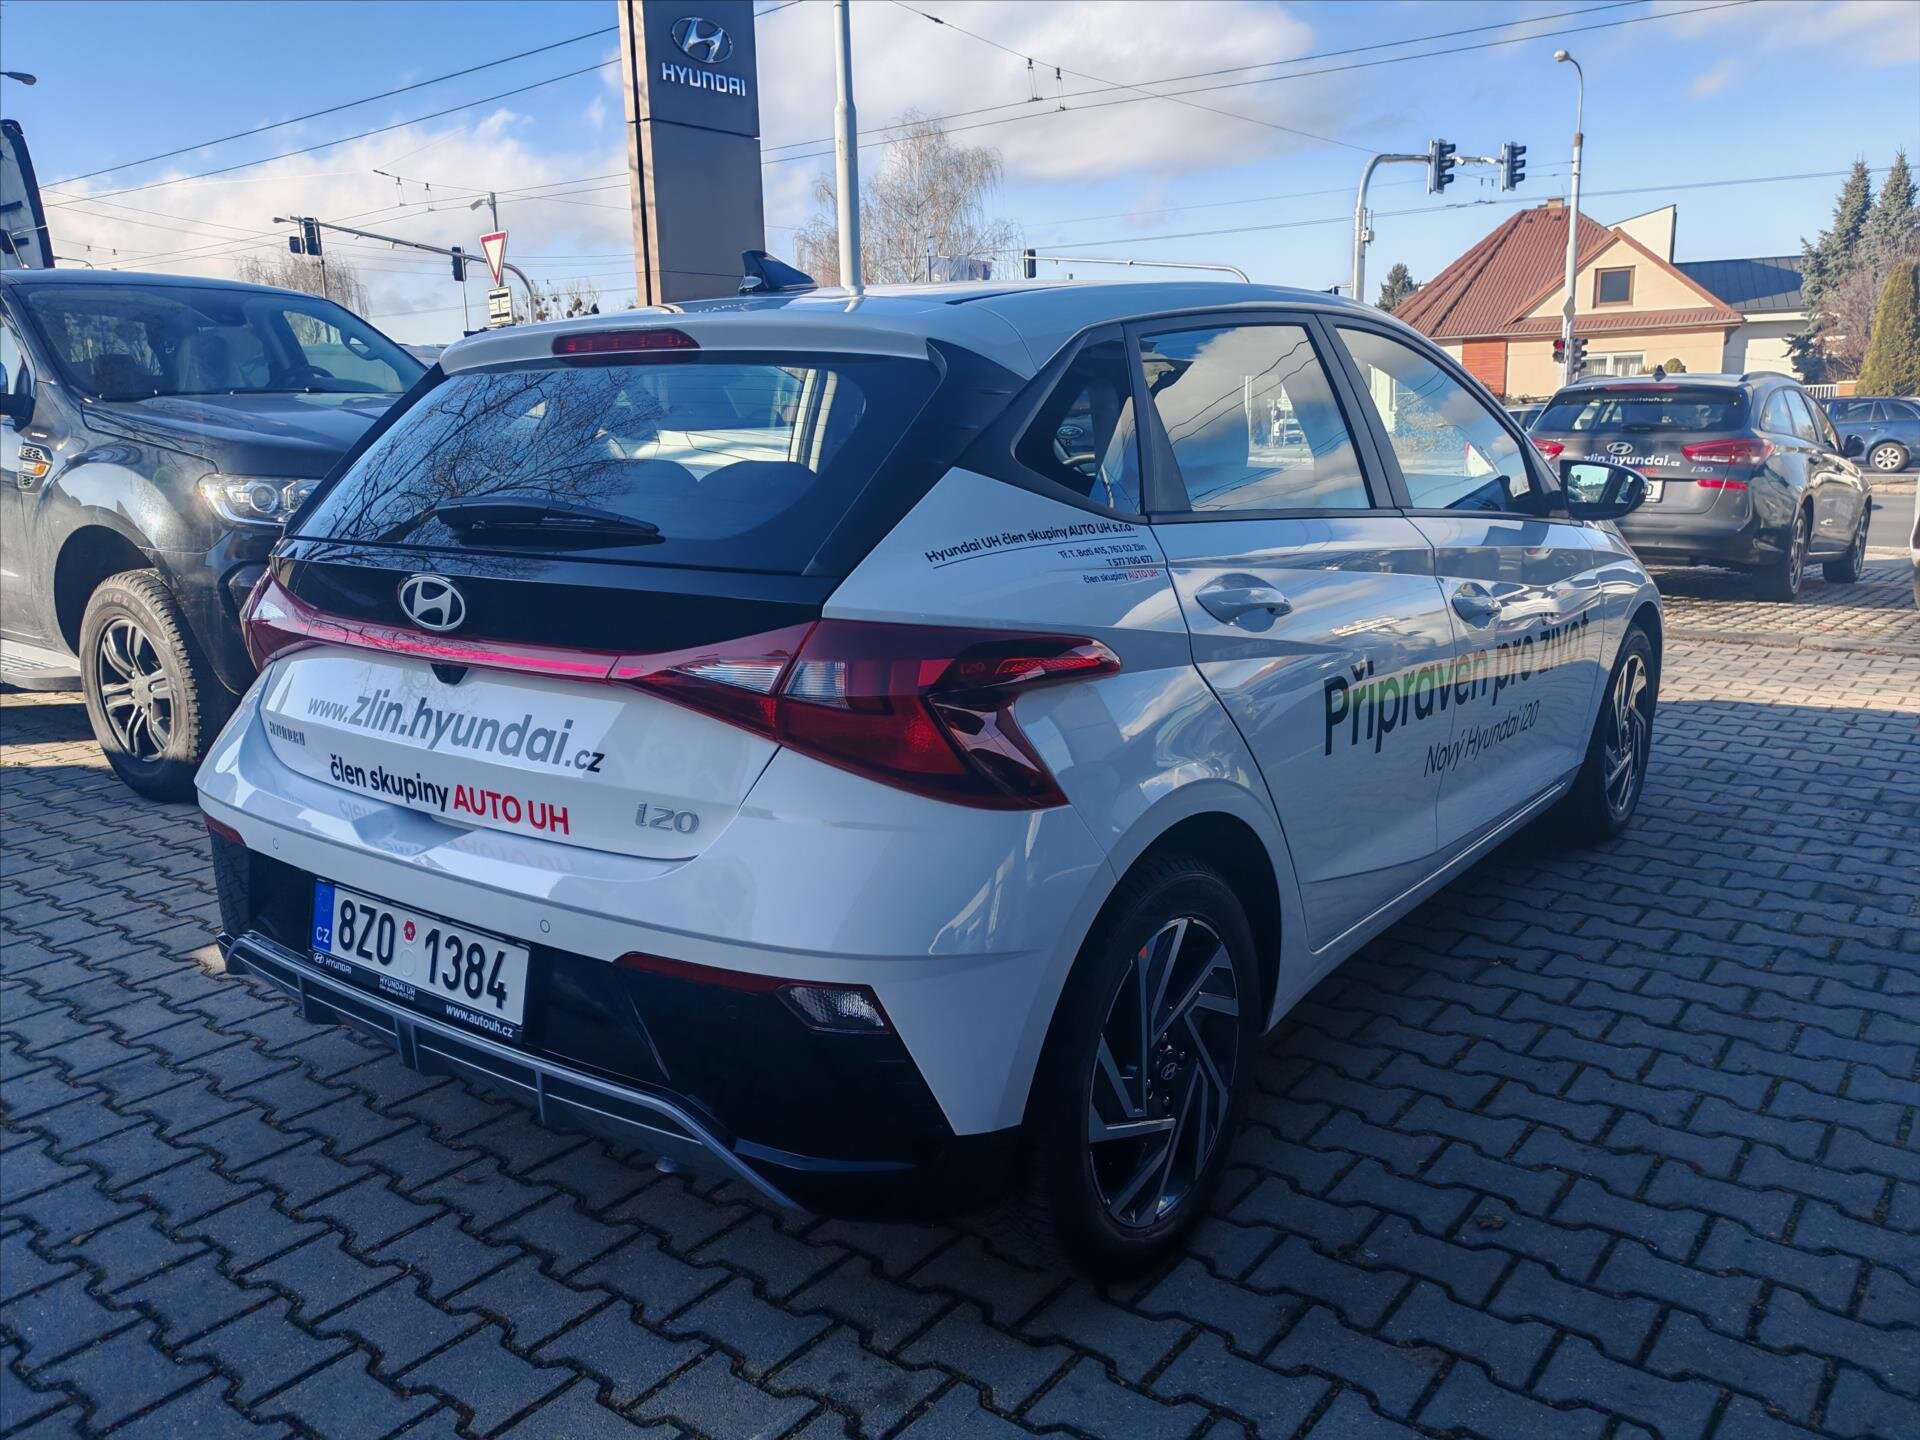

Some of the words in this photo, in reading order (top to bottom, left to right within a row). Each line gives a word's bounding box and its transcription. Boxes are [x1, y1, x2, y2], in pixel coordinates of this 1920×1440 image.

[661, 62, 746, 97] HYUNDAI
[925, 538, 982, 563] Hyundai
[981, 535, 1002, 550] UH
[1002, 533, 1028, 546] člen
[1028, 528, 1068, 543] skupiny
[1069, 524, 1096, 537] AUTO
[1098, 522, 1112, 533] UH
[1112, 524, 1135, 533] s.r.o.
[1123, 544, 1132, 552] 02
[1083, 574, 1101, 583] člen
[1101, 572, 1128, 582] skupiny
[1128, 569, 1148, 579] AUTO
[1148, 569, 1159, 577] UH
[1324, 648, 1489, 756] Připraven
[1492, 635, 1533, 706] pro
[307, 689, 605, 773] www.zlin.hyundai.cz
[1424, 729, 1466, 778] Nový
[1467, 706, 1520, 760] Hyundai
[1517, 700, 1540, 732] i20
[330, 753, 366, 787] člen
[370, 765, 448, 812] skupiny
[453, 783, 522, 824] AUTO
[528, 800, 570, 835] UH
[315, 926, 330, 944] CZ
[338, 899, 396, 966] 8Z0
[424, 928, 508, 1009] 1384
[326, 958, 351, 974] HYUNDAI
[445, 1004, 513, 1037] www.autouh.cz
